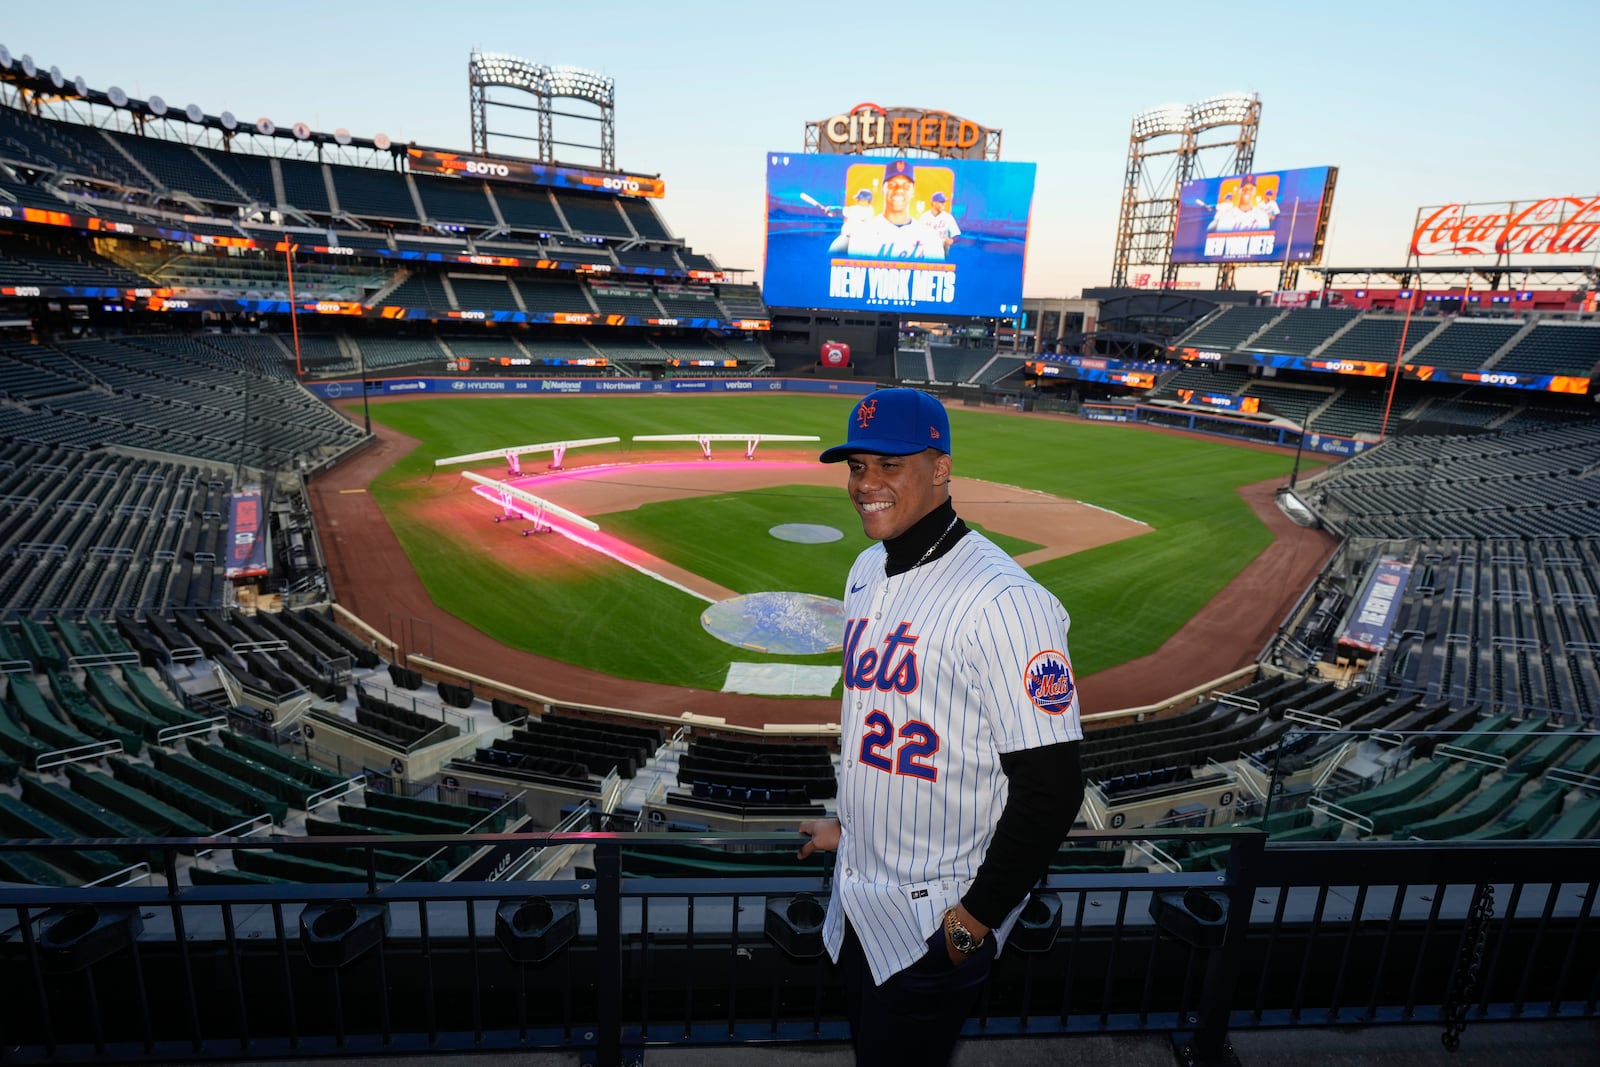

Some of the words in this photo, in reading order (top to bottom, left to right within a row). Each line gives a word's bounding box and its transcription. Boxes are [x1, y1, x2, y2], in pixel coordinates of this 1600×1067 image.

[827, 109, 886, 145] citi
[891, 117, 979, 148] FIELD
[466, 160, 509, 177] SOTO
[602, 177, 640, 191] SOTO
[327, 246, 354, 256] SOTO
[470, 256, 493, 264] SOTO
[591, 264, 611, 272] SOTO
[829, 265, 867, 299] NEW
[868, 266, 912, 301] YORK
[911, 270, 957, 304] METS
[162, 300, 189, 309] SOTO
[460, 311, 485, 319] SOTO
[565, 315, 587, 323] SOTO
[658, 318, 678, 326] SOTO
[1198, 351, 1222, 361] SOTO
[1326, 361, 1354, 371] SOTO
[1121, 375, 1140, 383] SOTO
[1480, 373, 1518, 385] SOTO
[467, 382, 505, 390] HYUNDAI
[551, 381, 582, 389] National
[603, 382, 641, 390] Northwell
[725, 381, 752, 389] verizon
[1211, 397, 1231, 406] SOTO
[859, 708, 940, 783] 22
[1223, 793, 1231, 804] B
[1113, 815, 1122, 827] B
